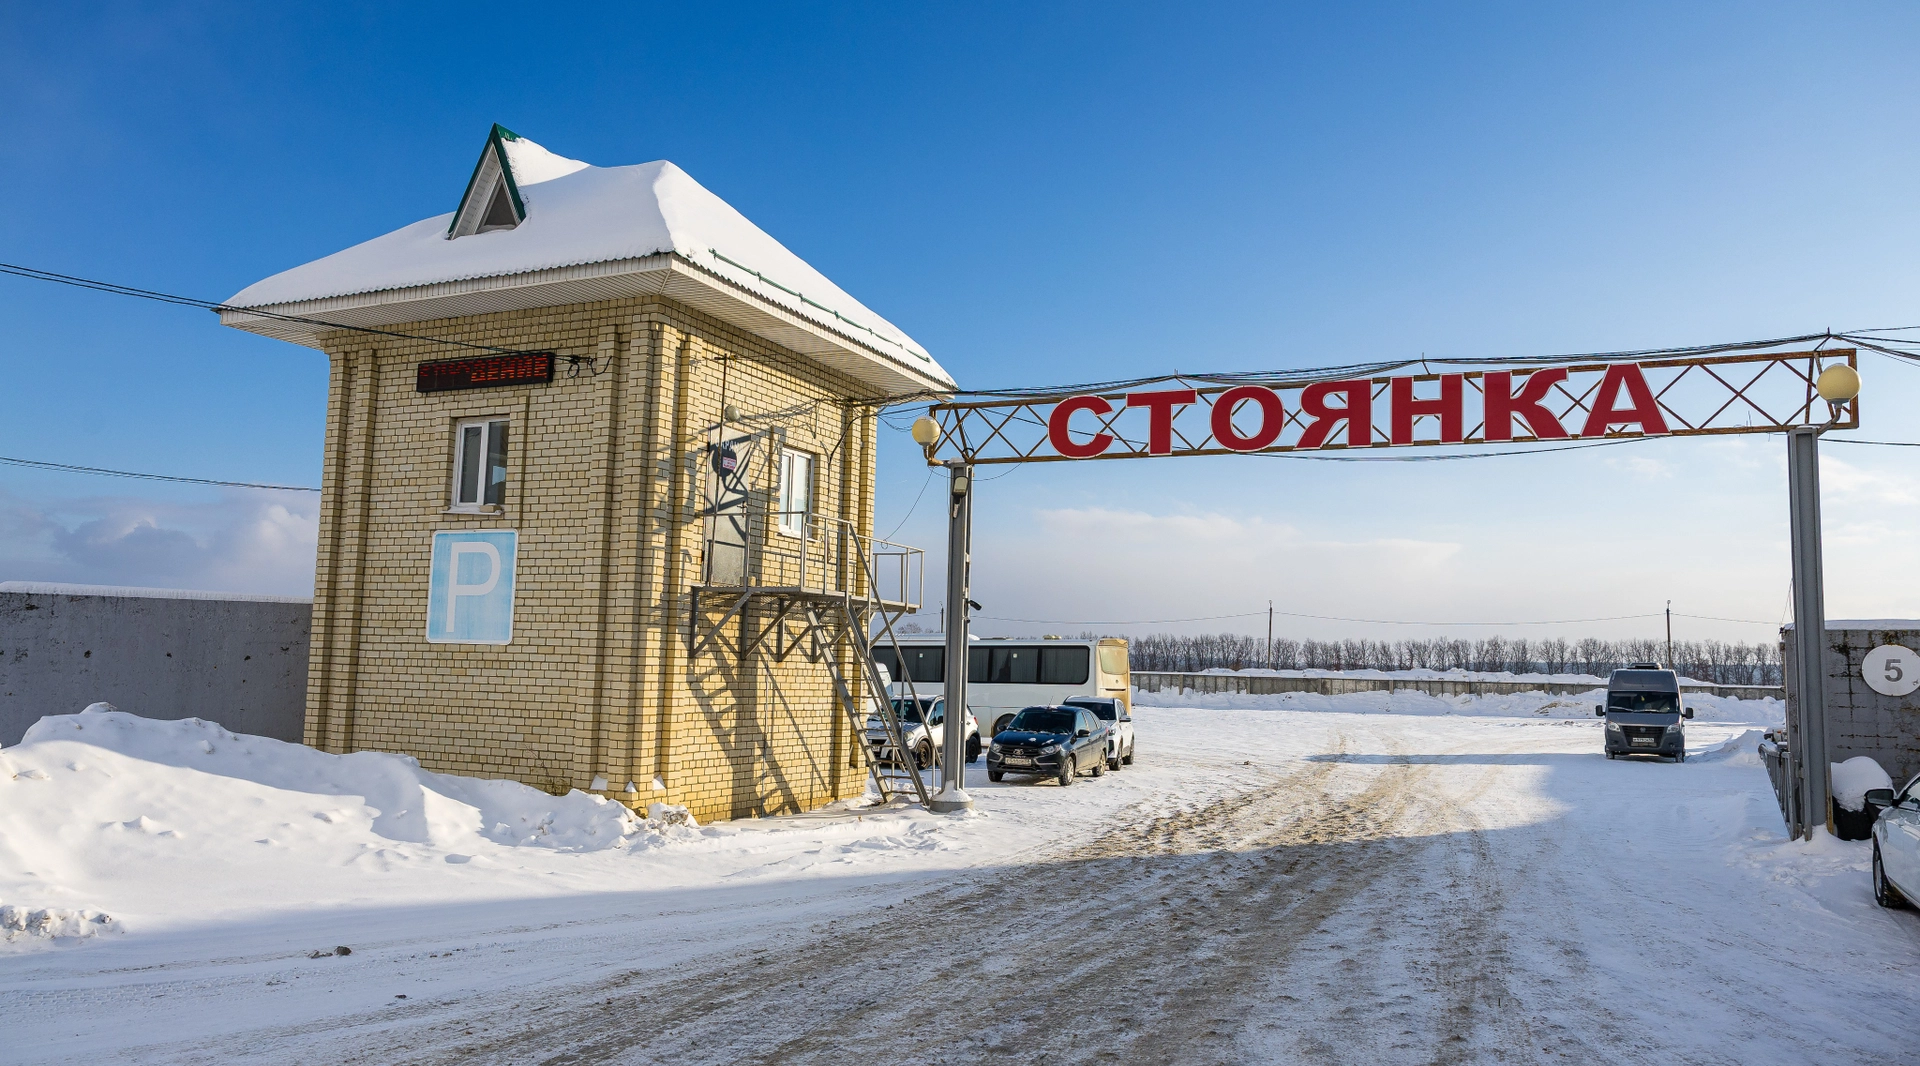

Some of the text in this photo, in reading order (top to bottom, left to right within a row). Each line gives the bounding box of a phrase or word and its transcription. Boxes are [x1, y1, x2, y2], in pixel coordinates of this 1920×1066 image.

[1048, 362, 1672, 460] СТОЯНКА
[445, 541, 501, 633] P
[1884, 658, 1903, 682] 5
